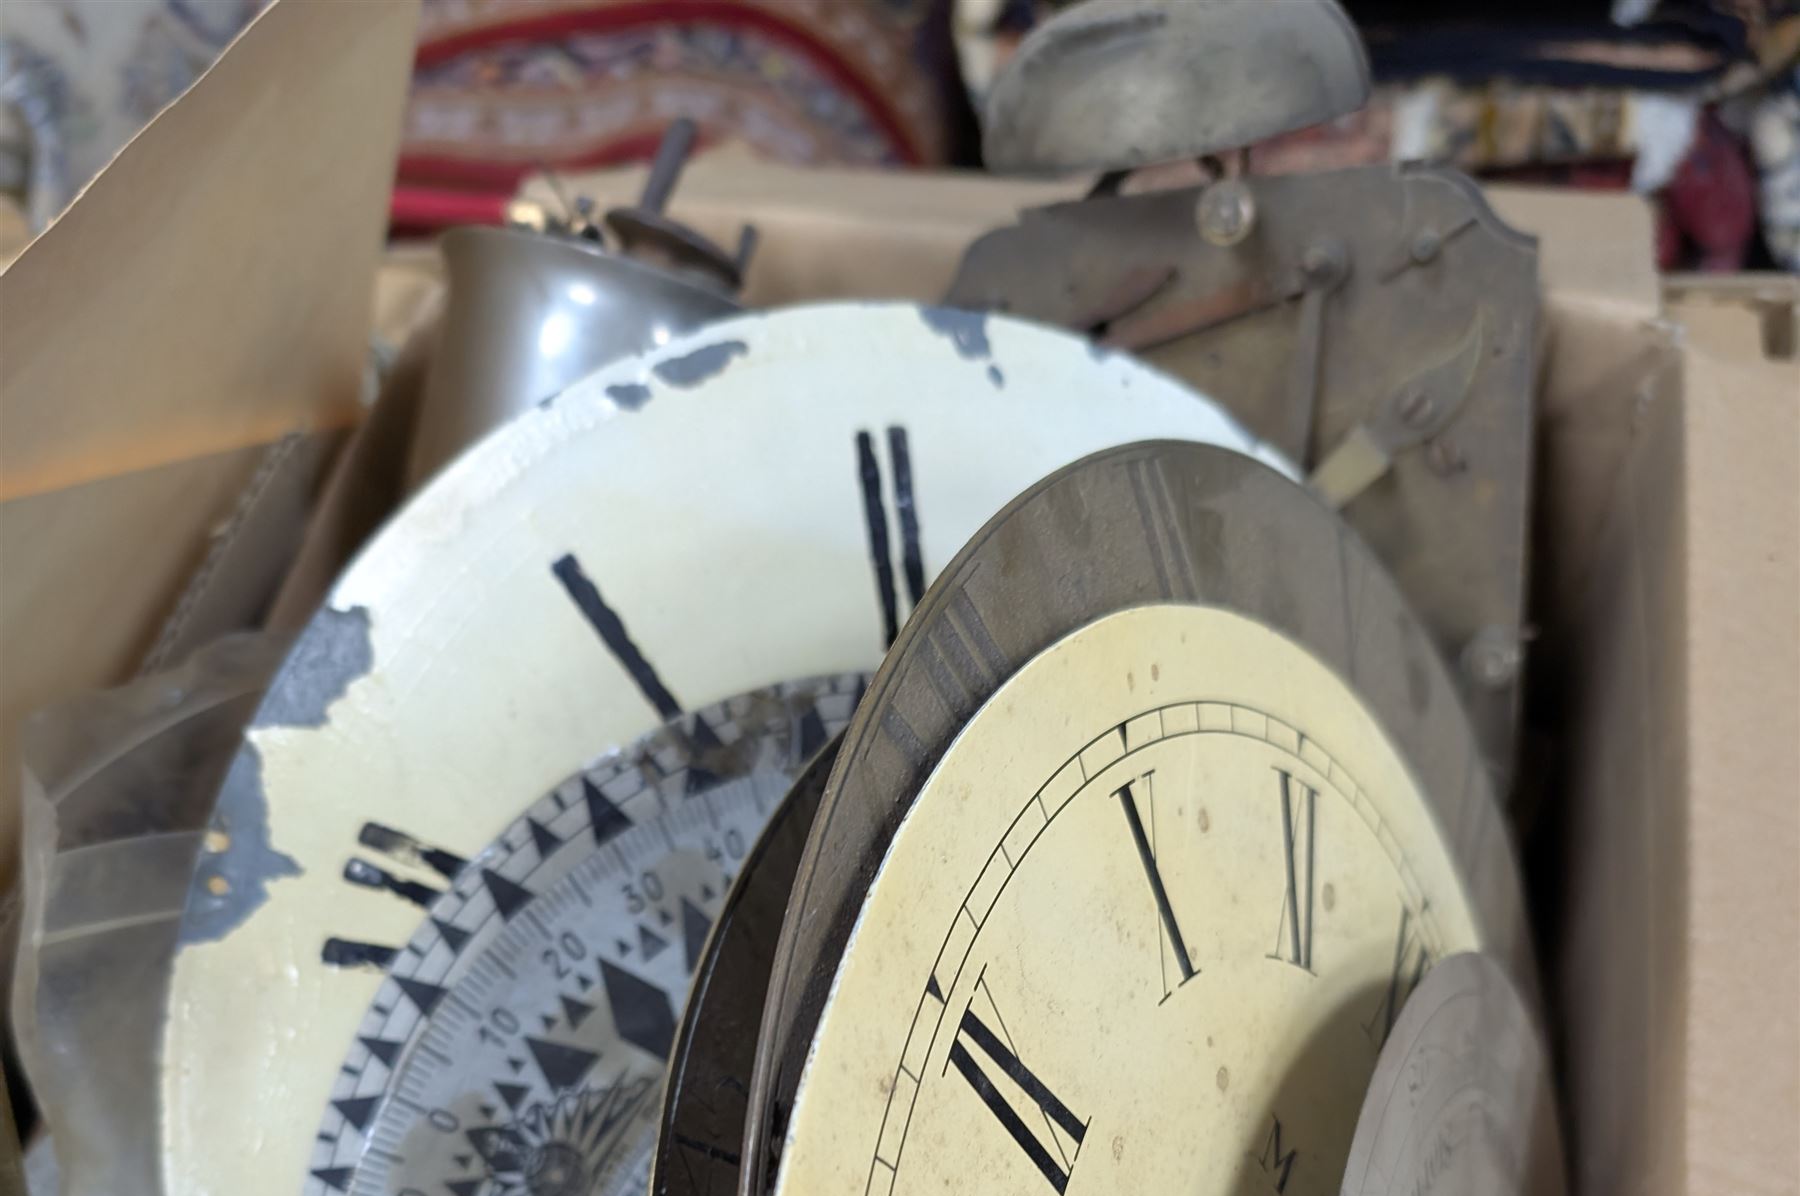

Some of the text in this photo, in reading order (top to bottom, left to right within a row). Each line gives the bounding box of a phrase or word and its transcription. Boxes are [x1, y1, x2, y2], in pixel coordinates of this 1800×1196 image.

[622, 870, 663, 916] 30
[1109, 769, 1201, 1006] X
[1265, 766, 1320, 977] XI
[541, 930, 587, 982] 20
[478, 1008, 520, 1053] 10
